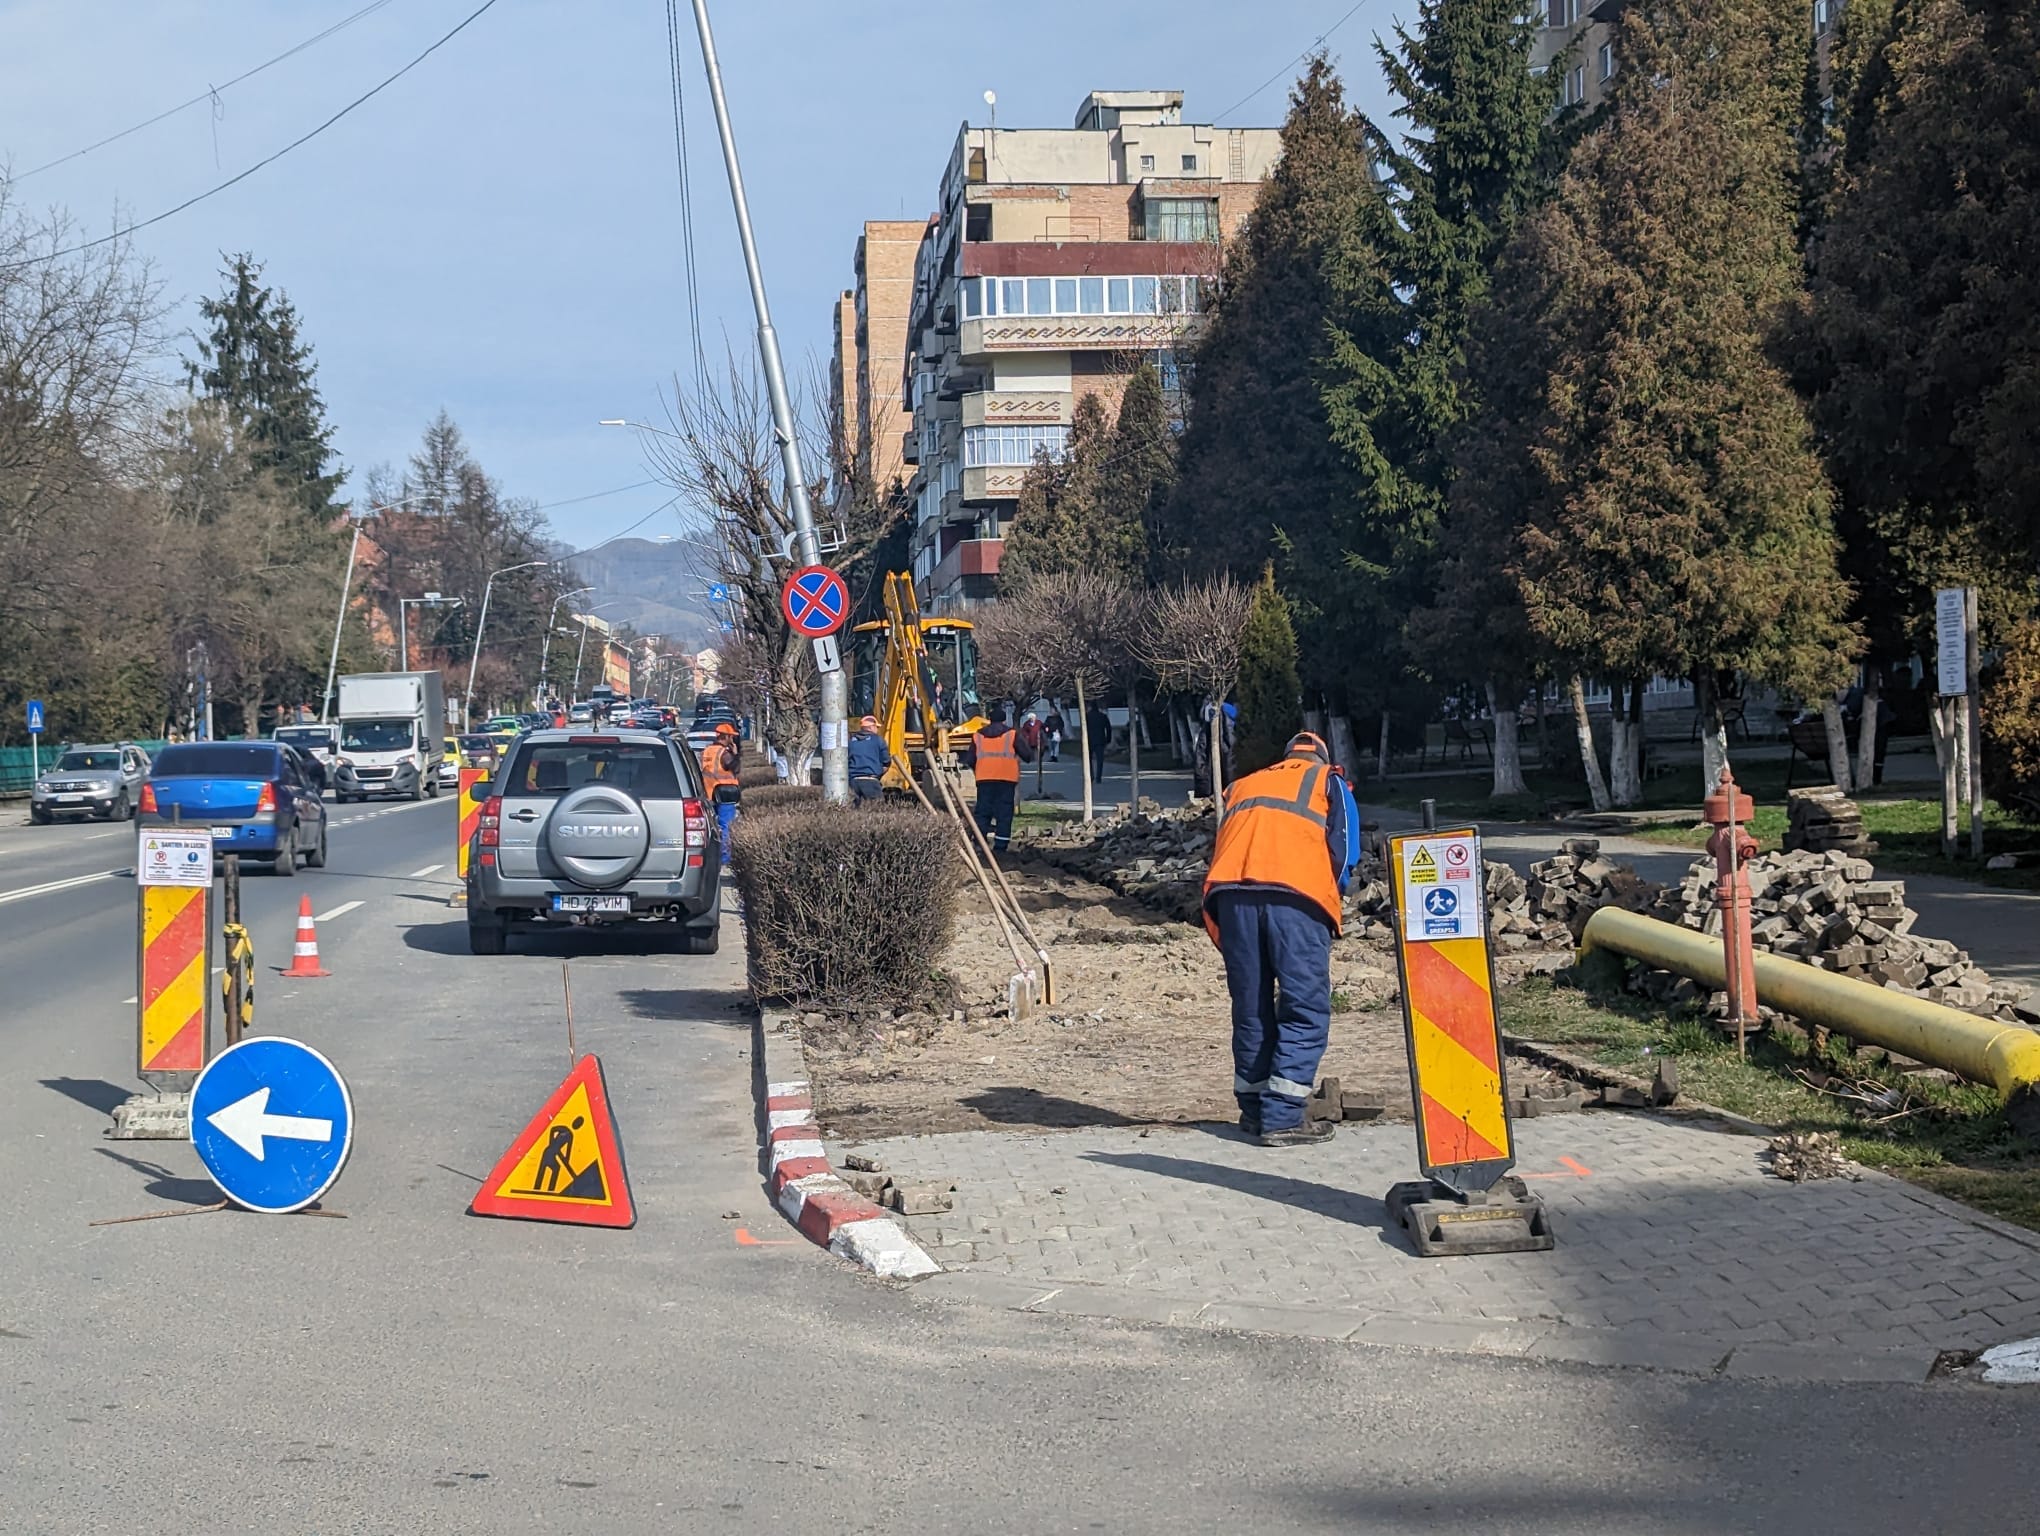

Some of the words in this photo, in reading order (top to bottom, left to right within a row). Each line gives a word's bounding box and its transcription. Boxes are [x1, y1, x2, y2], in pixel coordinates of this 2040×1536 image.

[557, 825, 640, 839] SUZUKI
[561, 896, 580, 909] HD
[584, 896, 599, 909] 76
[603, 896, 623, 909] VIM
